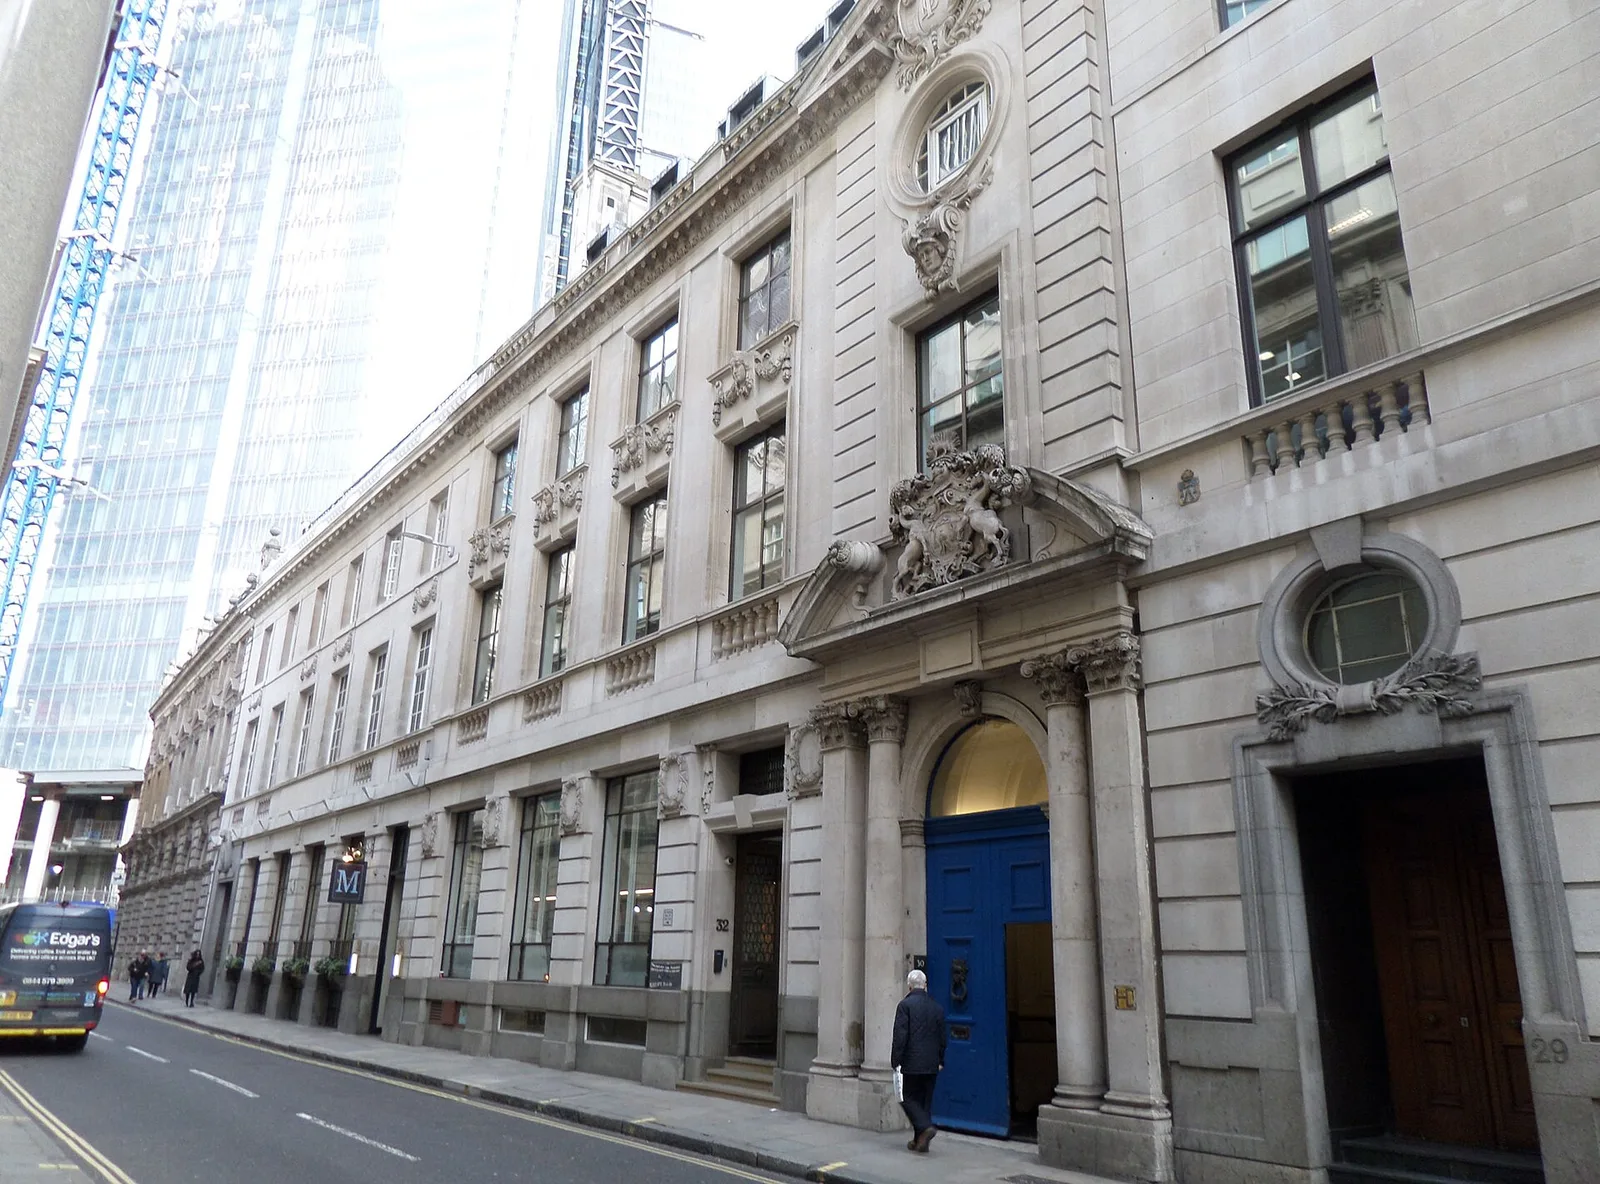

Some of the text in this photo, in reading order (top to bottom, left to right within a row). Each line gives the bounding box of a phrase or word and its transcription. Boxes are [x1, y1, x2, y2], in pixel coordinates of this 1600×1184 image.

[335, 869, 361, 894] M
[716, 919, 729, 932] 32
[49, 931, 101, 949] Edgar's
[1531, 1038, 1569, 1064] 29
